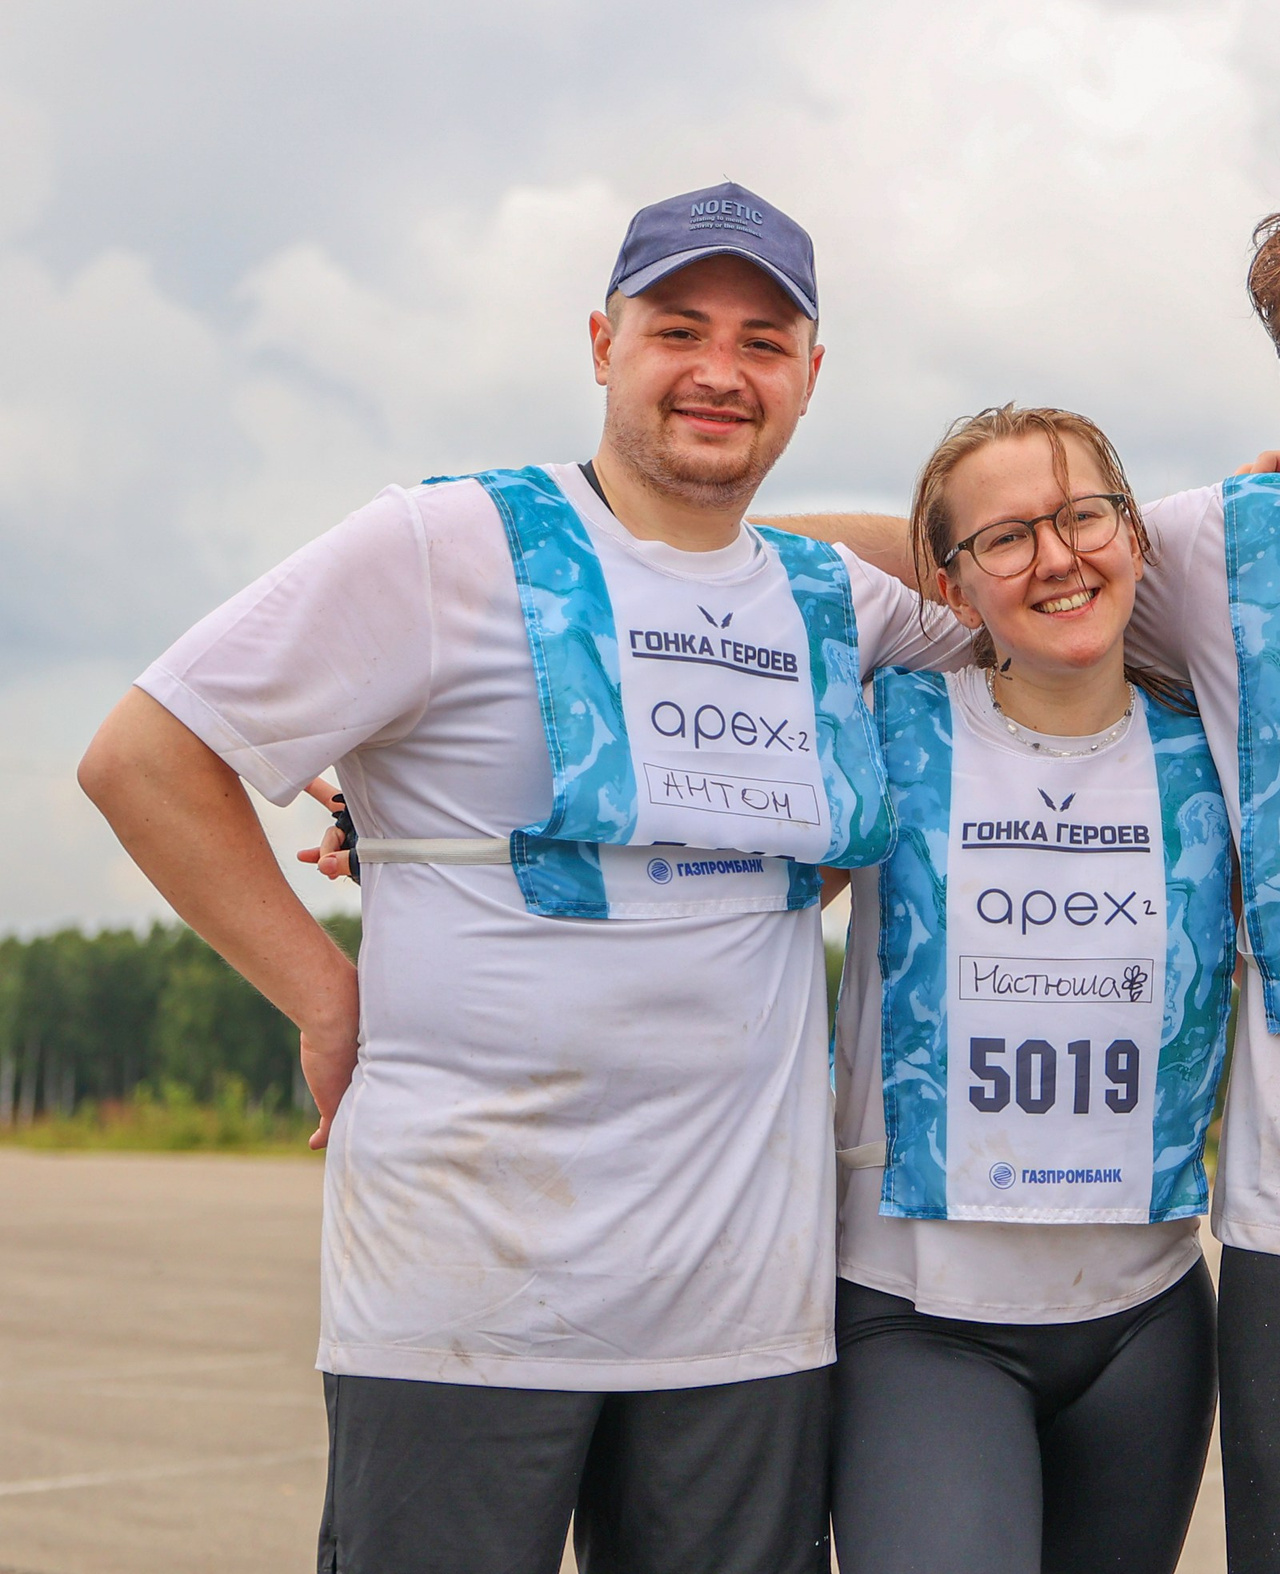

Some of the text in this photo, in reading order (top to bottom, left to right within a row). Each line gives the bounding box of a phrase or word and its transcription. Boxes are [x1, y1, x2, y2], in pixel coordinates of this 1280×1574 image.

[690, 199, 763, 225] NOETIC
[723, 222, 735, 231] the
[629, 629, 798, 673] ГОНКА ГЕРОЕВ
[663, 771, 792, 819] АНТОН
[962, 820, 1150, 845] ГОНКА ГЕРОЕВ
[676, 858, 765, 877] ГАЗПРОМБАНК
[976, 888, 1138, 936] apex
[973, 961, 1121, 999] Настюша
[968, 1037, 1140, 1114] 5019
[1021, 1168, 1123, 1184] ГАЗПРОМБАНК
